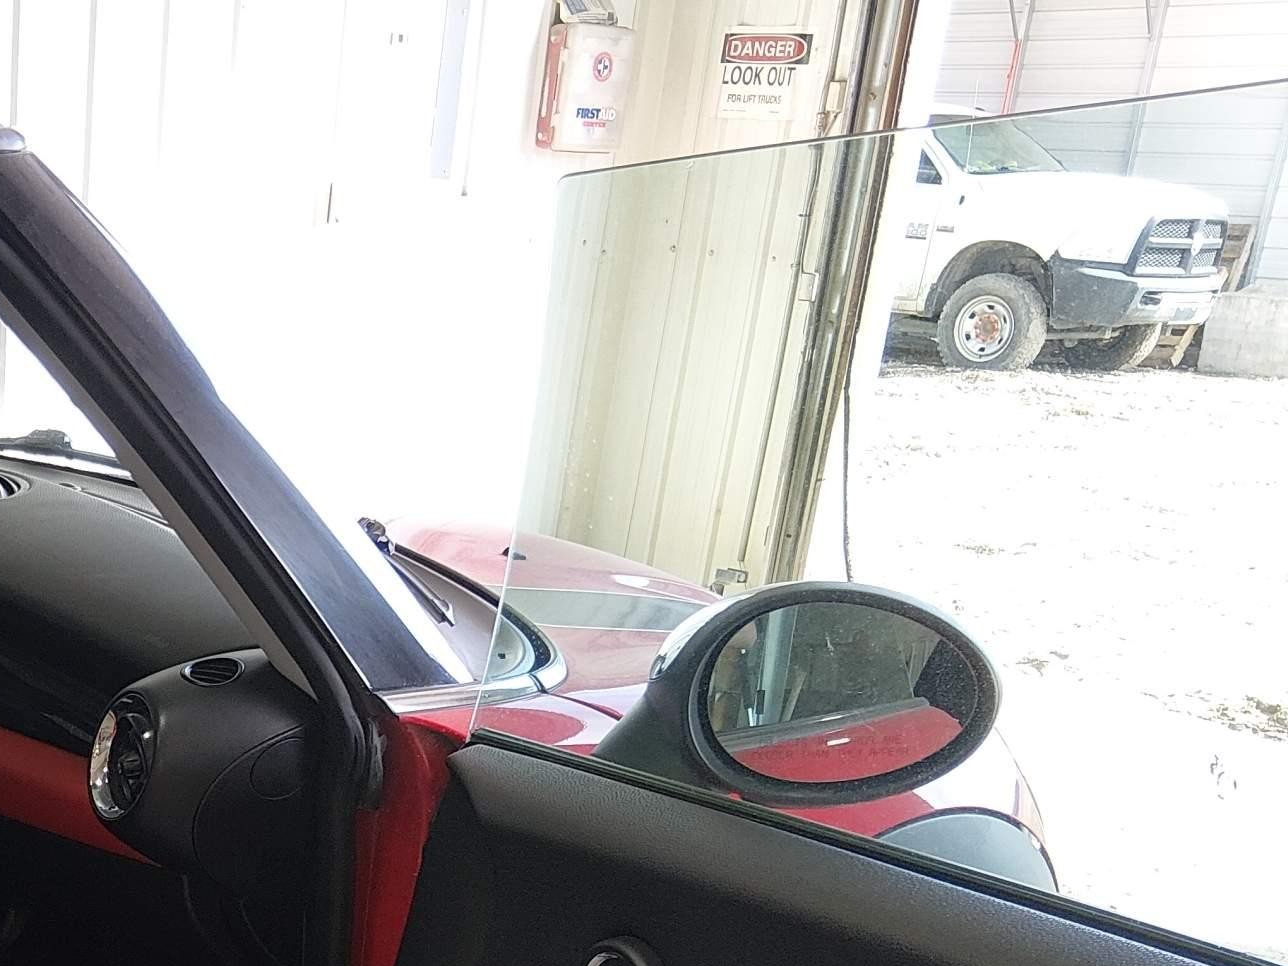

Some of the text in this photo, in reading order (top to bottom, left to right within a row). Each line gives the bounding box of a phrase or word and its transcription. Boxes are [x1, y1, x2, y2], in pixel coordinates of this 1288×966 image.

[729, 40, 796, 57] DANGER
[722, 65, 797, 87] LOOK OUT
[727, 93, 782, 105] FOR LIFT TRUCKS
